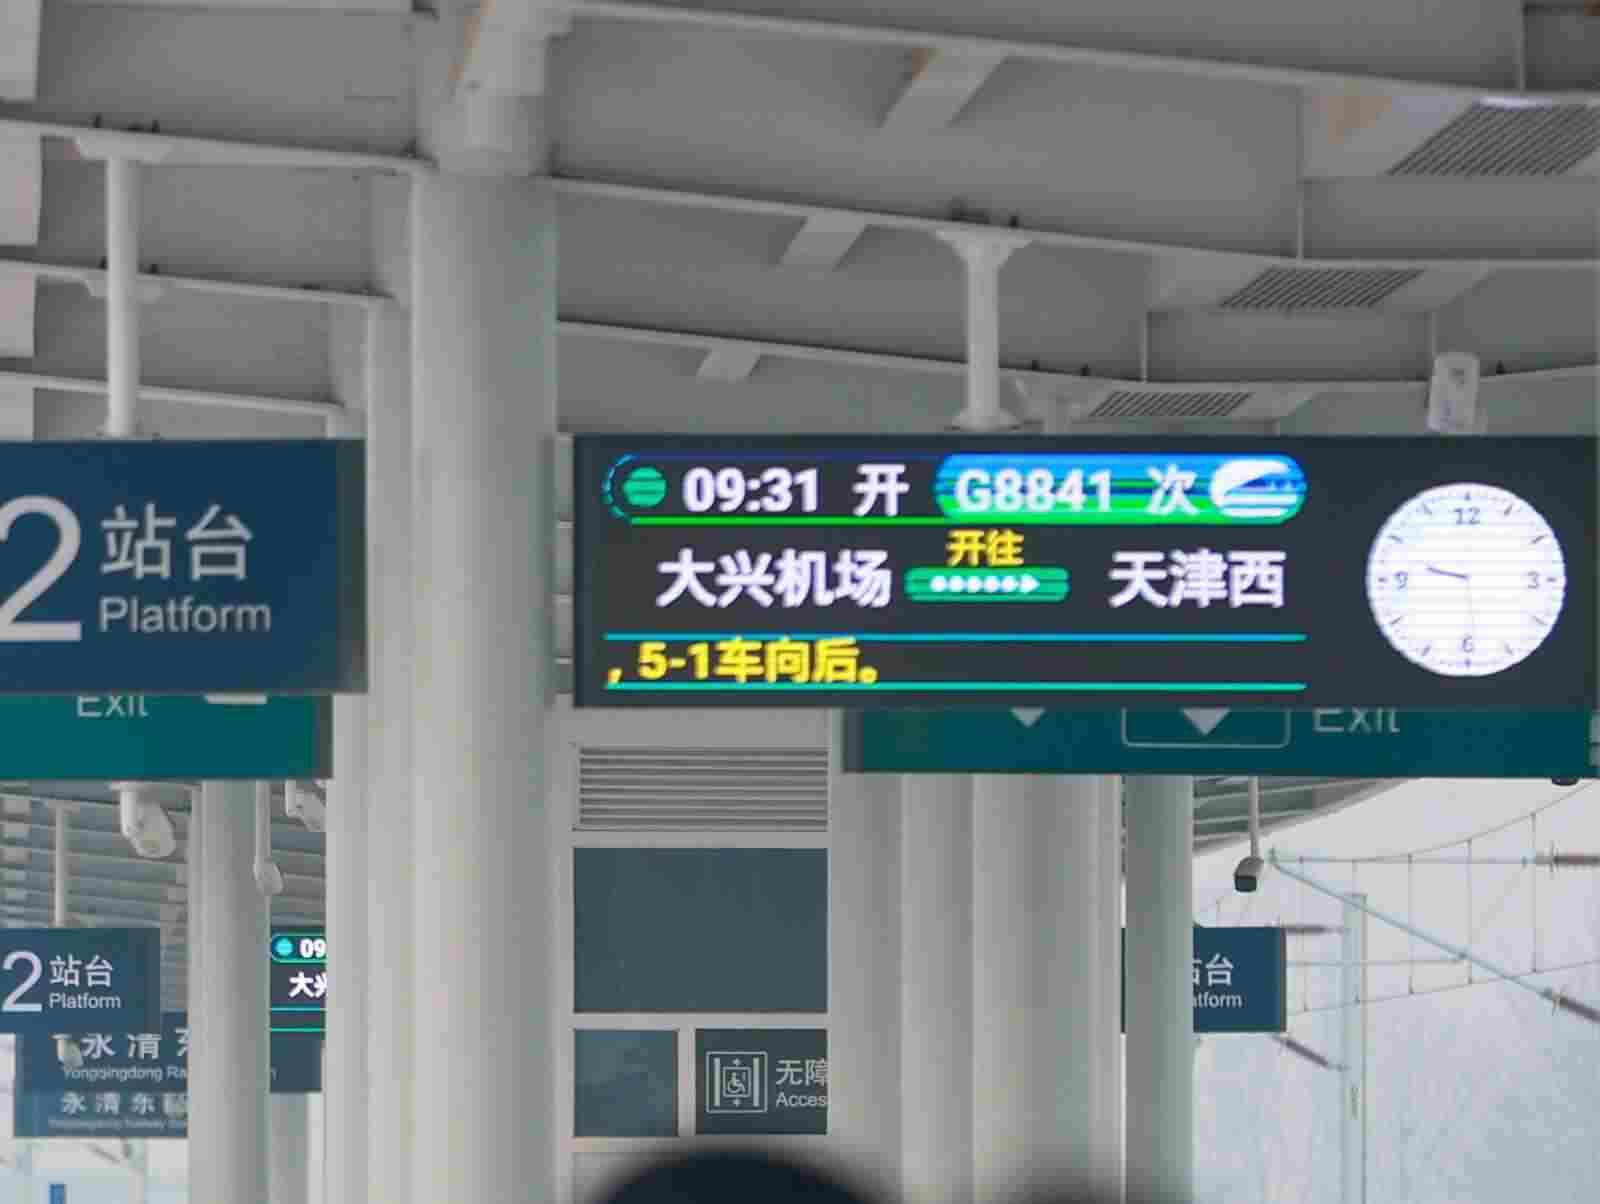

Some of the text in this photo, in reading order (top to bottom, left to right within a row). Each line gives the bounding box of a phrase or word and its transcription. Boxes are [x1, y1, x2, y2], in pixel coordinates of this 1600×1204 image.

[683, 463, 1199, 516] 09:31 开 G8841 次
[1456, 507, 1480, 525] 12
[101, 503, 252, 580] 站台
[946, 529, 1024, 567] 开往
[656, 549, 892, 608] 大兴机场
[1108, 549, 1287, 608] 天津西
[99, 597, 271, 632] Platform
[2, 950, 113, 1012] 2 站台
[1193, 952, 1234, 986] 台
[49, 993, 121, 1009] Platform
